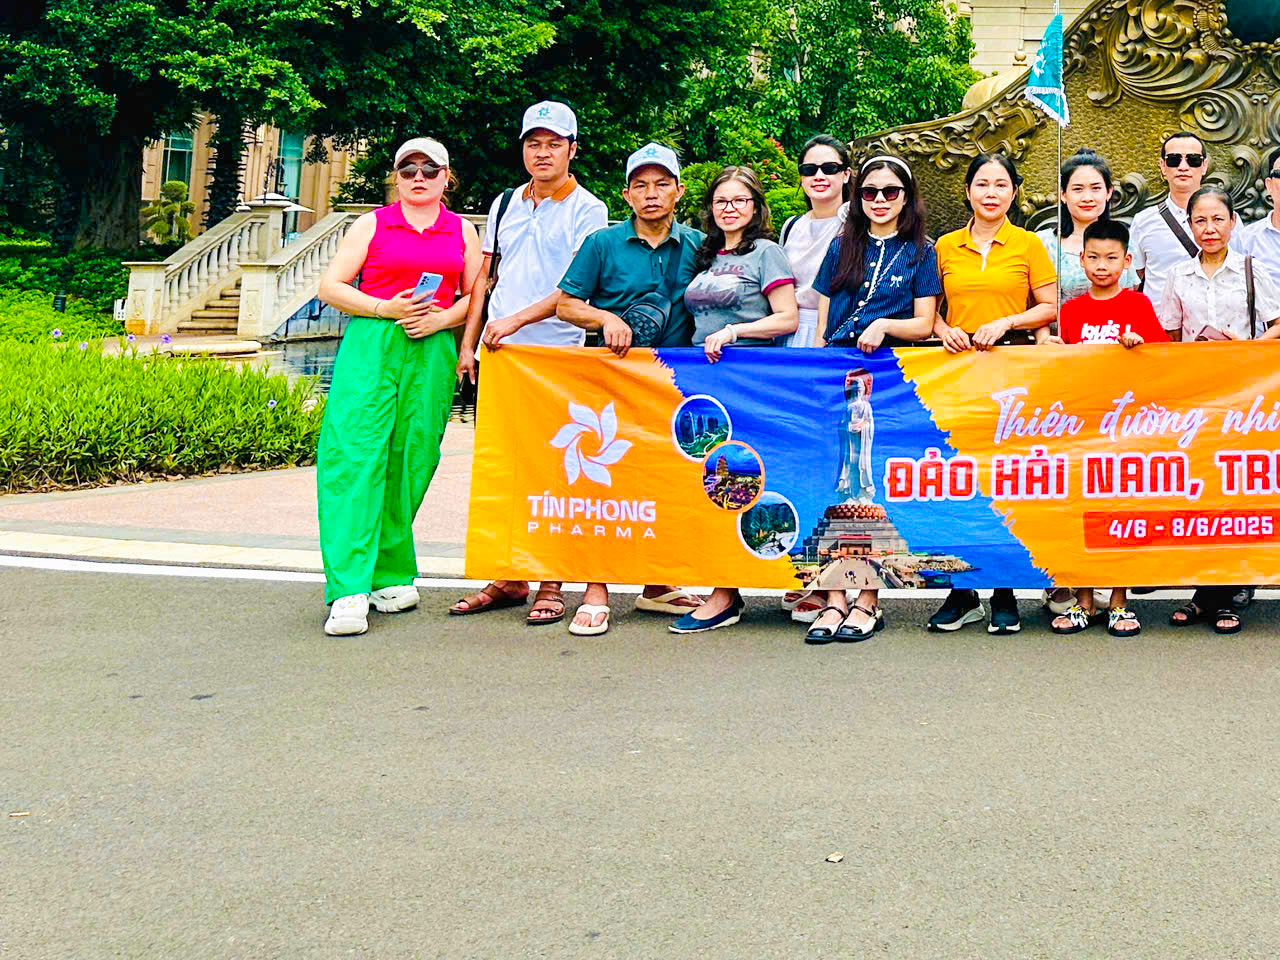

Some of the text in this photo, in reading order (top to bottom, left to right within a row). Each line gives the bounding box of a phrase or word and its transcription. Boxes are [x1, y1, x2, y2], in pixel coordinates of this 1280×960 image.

[992, 387, 1084, 443] Thiên
[1099, 391, 1208, 448] đường
[886, 449, 974, 499] ĐẢO
[993, 447, 1066, 498] HẢI
[1085, 453, 1203, 500] NAM,
[527, 521, 657, 539] PHARMA
[1108, 519, 1147, 538] 4/6
[1172, 516, 1273, 537] 8/6/2025
